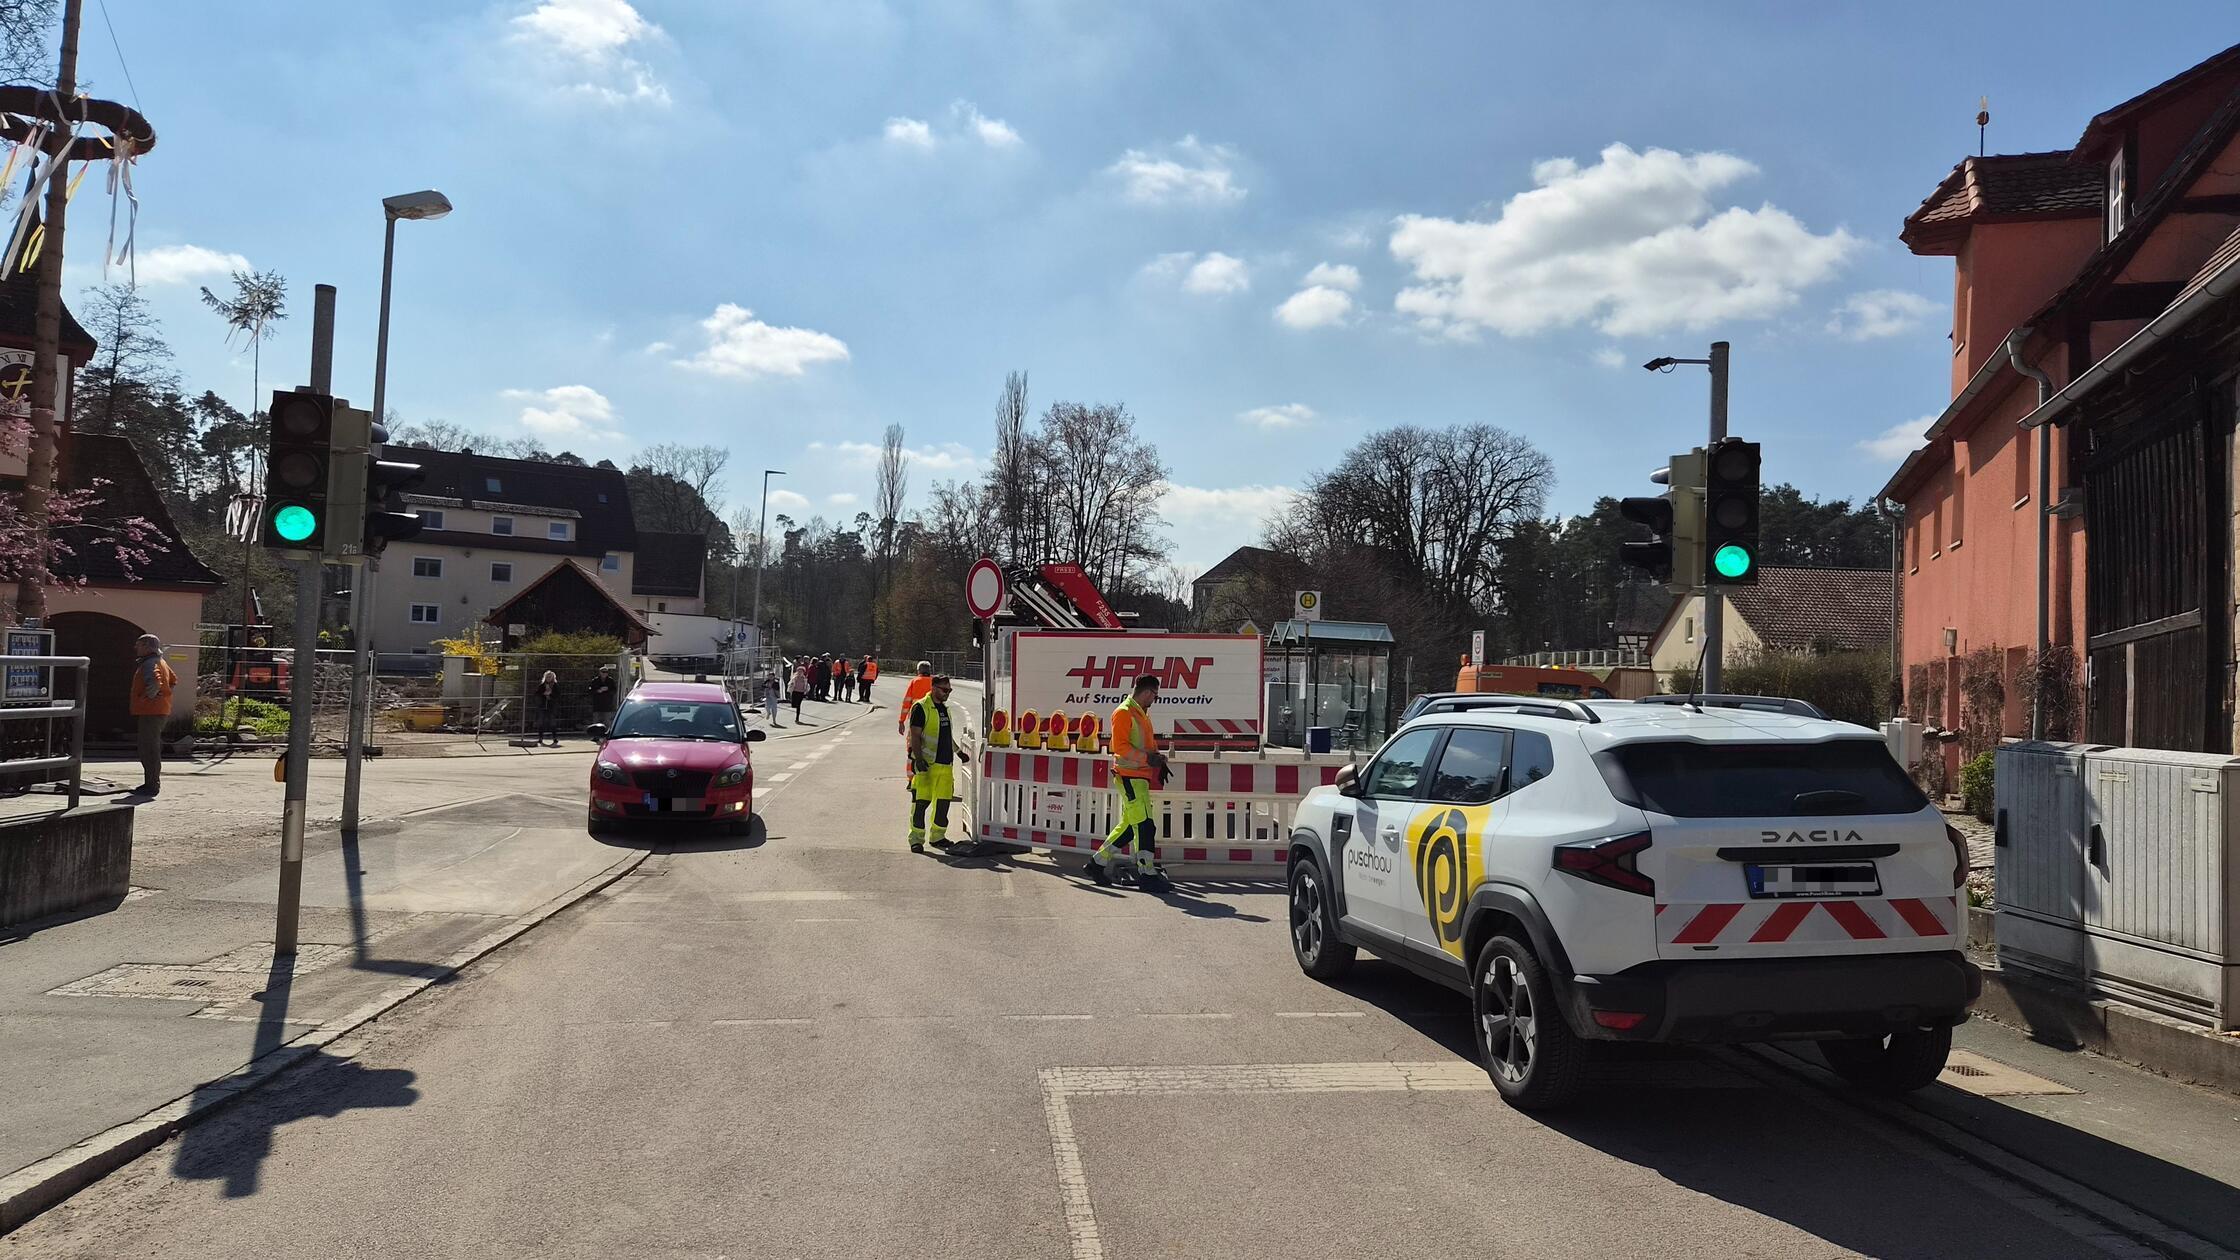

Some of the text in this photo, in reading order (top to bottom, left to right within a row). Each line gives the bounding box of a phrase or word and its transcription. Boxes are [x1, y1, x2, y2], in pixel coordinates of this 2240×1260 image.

[1096, 600, 1111, 617] F235
[1065, 655, 1214, 689] HAHN
[1065, 693, 1213, 704] Auf Straß nnovativ
[1761, 830, 1863, 843] DACIA
[1348, 846, 1392, 873] puschbau
